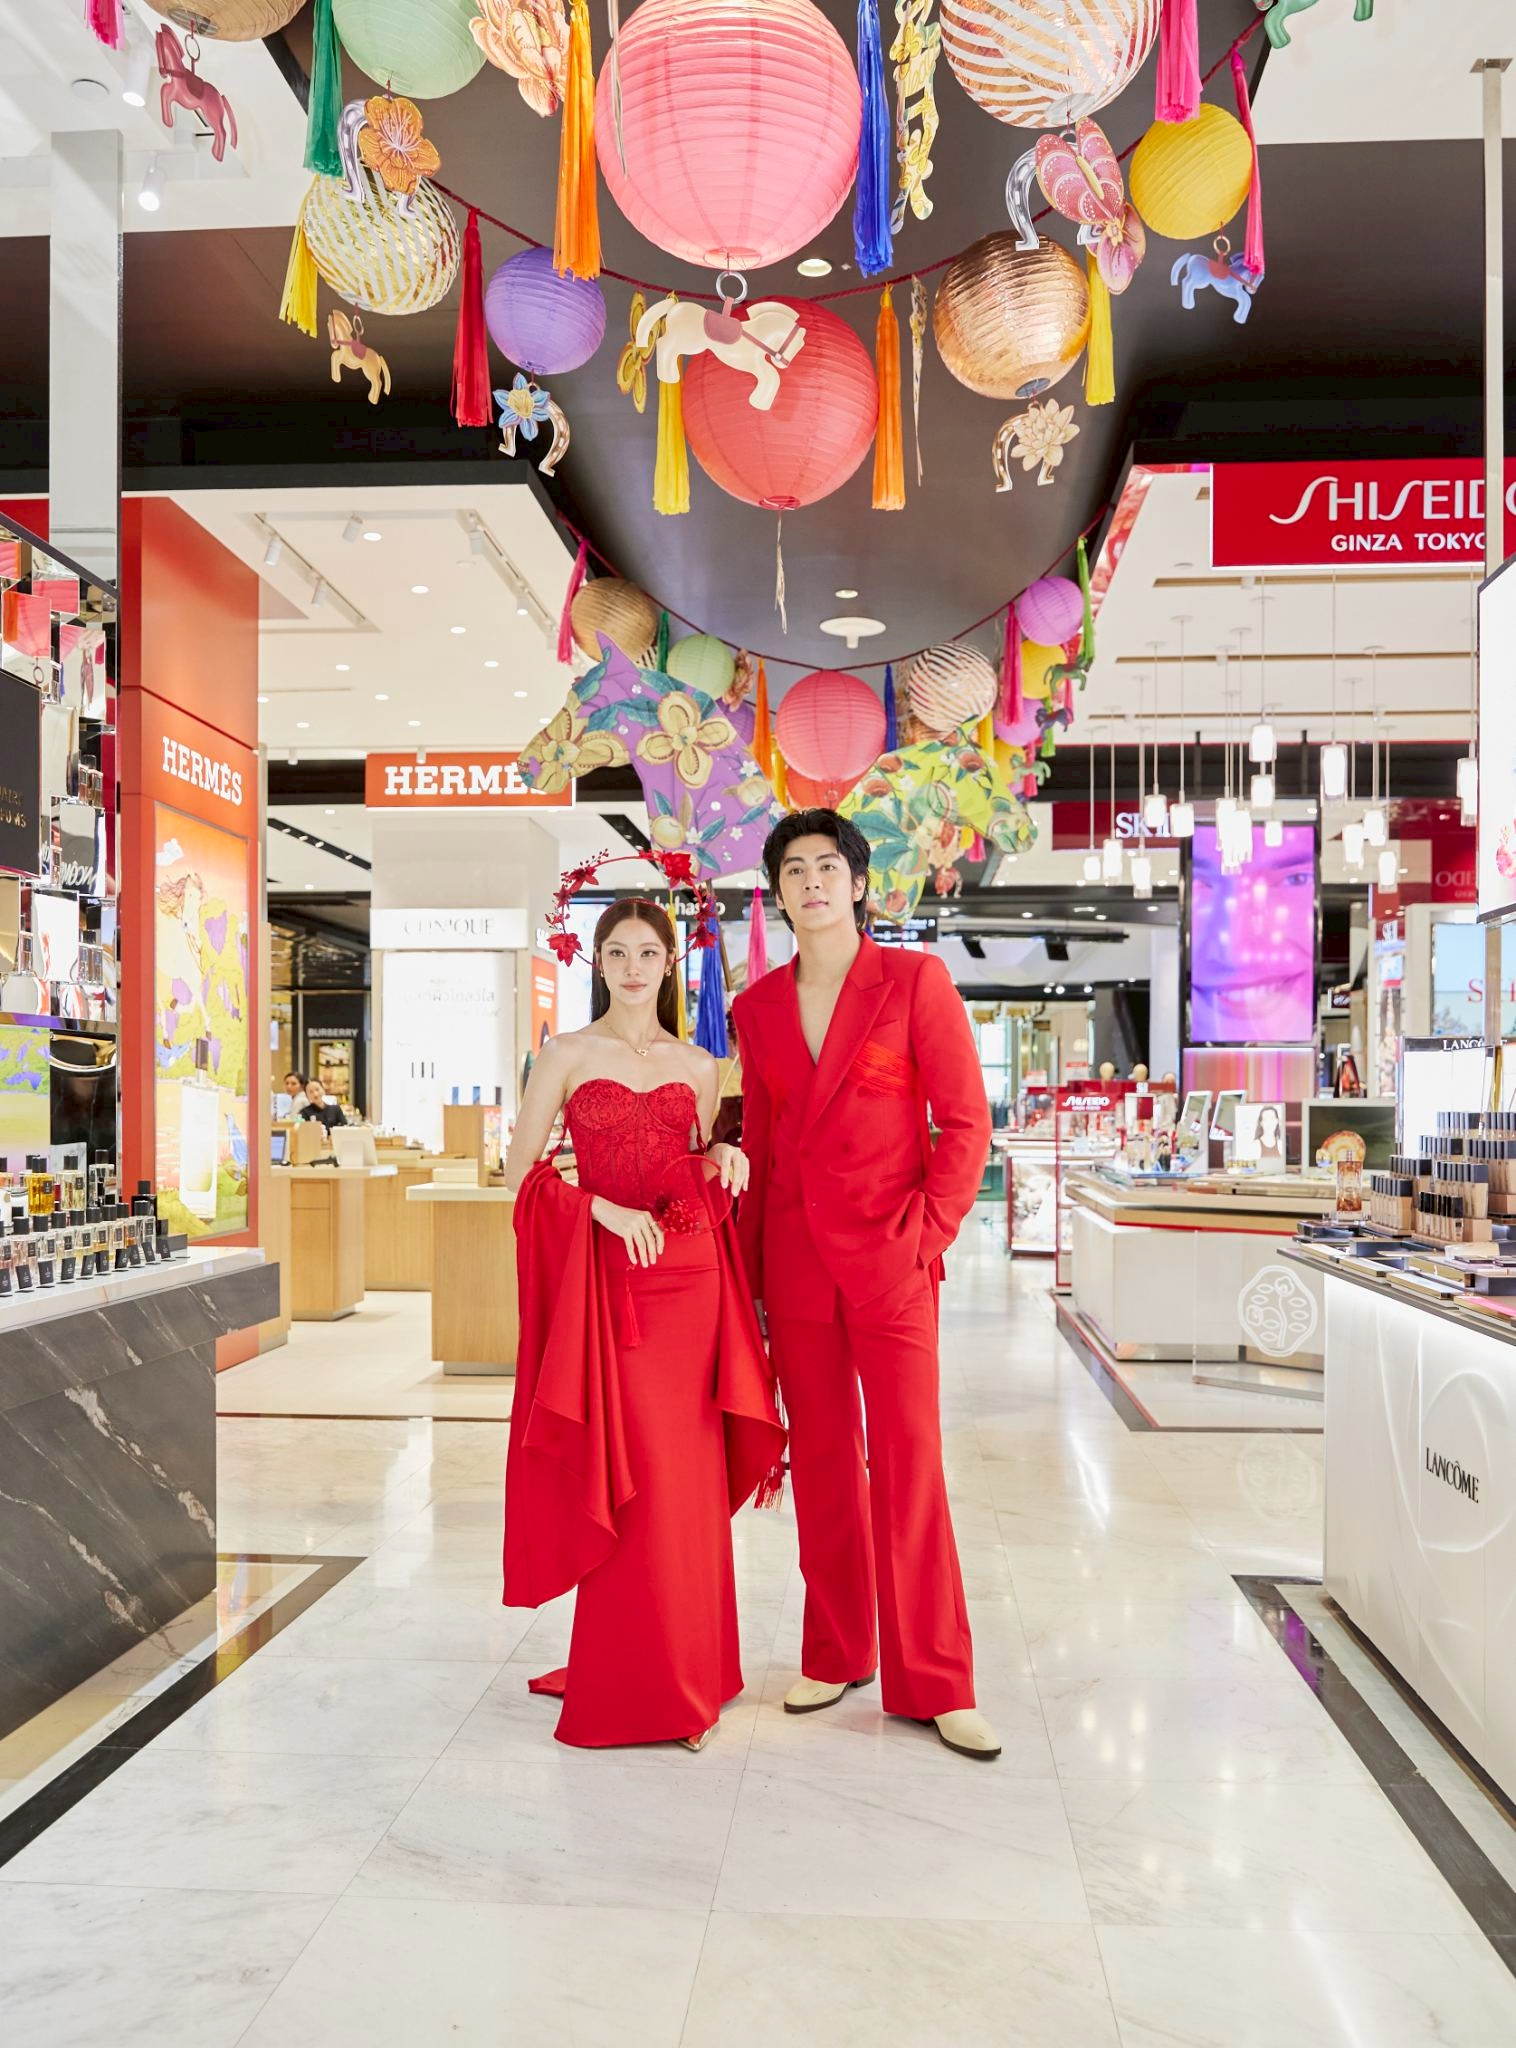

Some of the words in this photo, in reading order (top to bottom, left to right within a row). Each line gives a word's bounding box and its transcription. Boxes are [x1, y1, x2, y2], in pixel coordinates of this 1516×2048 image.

[1269, 475, 1516, 525] SHISEI
[1331, 533, 1403, 552] GINZA
[1414, 532, 1485, 550] TOKYO
[162, 735, 243, 806] HERMÈS
[385, 761, 547, 796] HERMÈ
[403, 918, 495, 937] CLINIQUE
[307, 1027, 359, 1038] BURBERRY
[1426, 1447, 1479, 1504] LANCÔME
